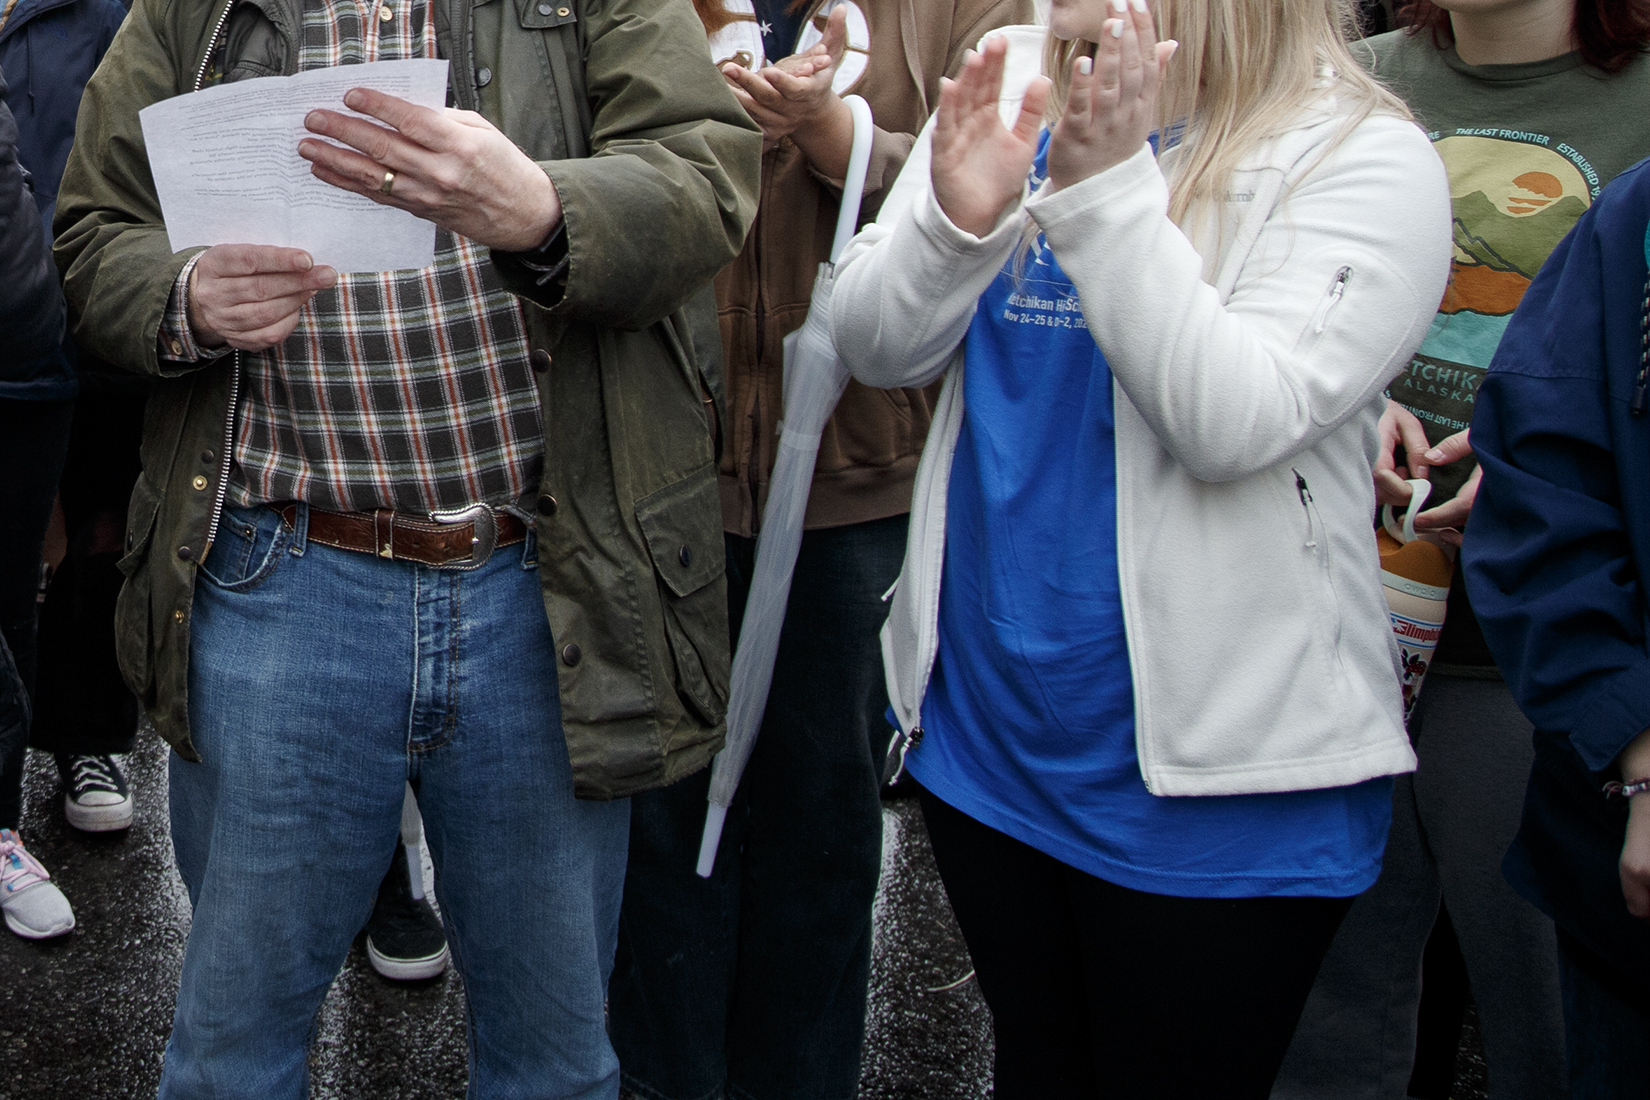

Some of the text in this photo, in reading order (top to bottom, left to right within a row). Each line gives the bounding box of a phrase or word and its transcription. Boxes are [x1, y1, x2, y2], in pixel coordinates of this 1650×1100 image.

[1455, 128, 1474, 136] THE
[1474, 128, 1499, 136] LAST
[1499, 129, 1550, 146] FRONTIER
[1556, 142, 1600, 186] ESTABLISHED
[1003, 308, 1019, 322] Nov
[1047, 315, 1054, 327] &
[1073, 317, 1088, 329] 202
[1406, 359, 1478, 391] TCHIK
[1403, 378, 1475, 404] ALASKA
